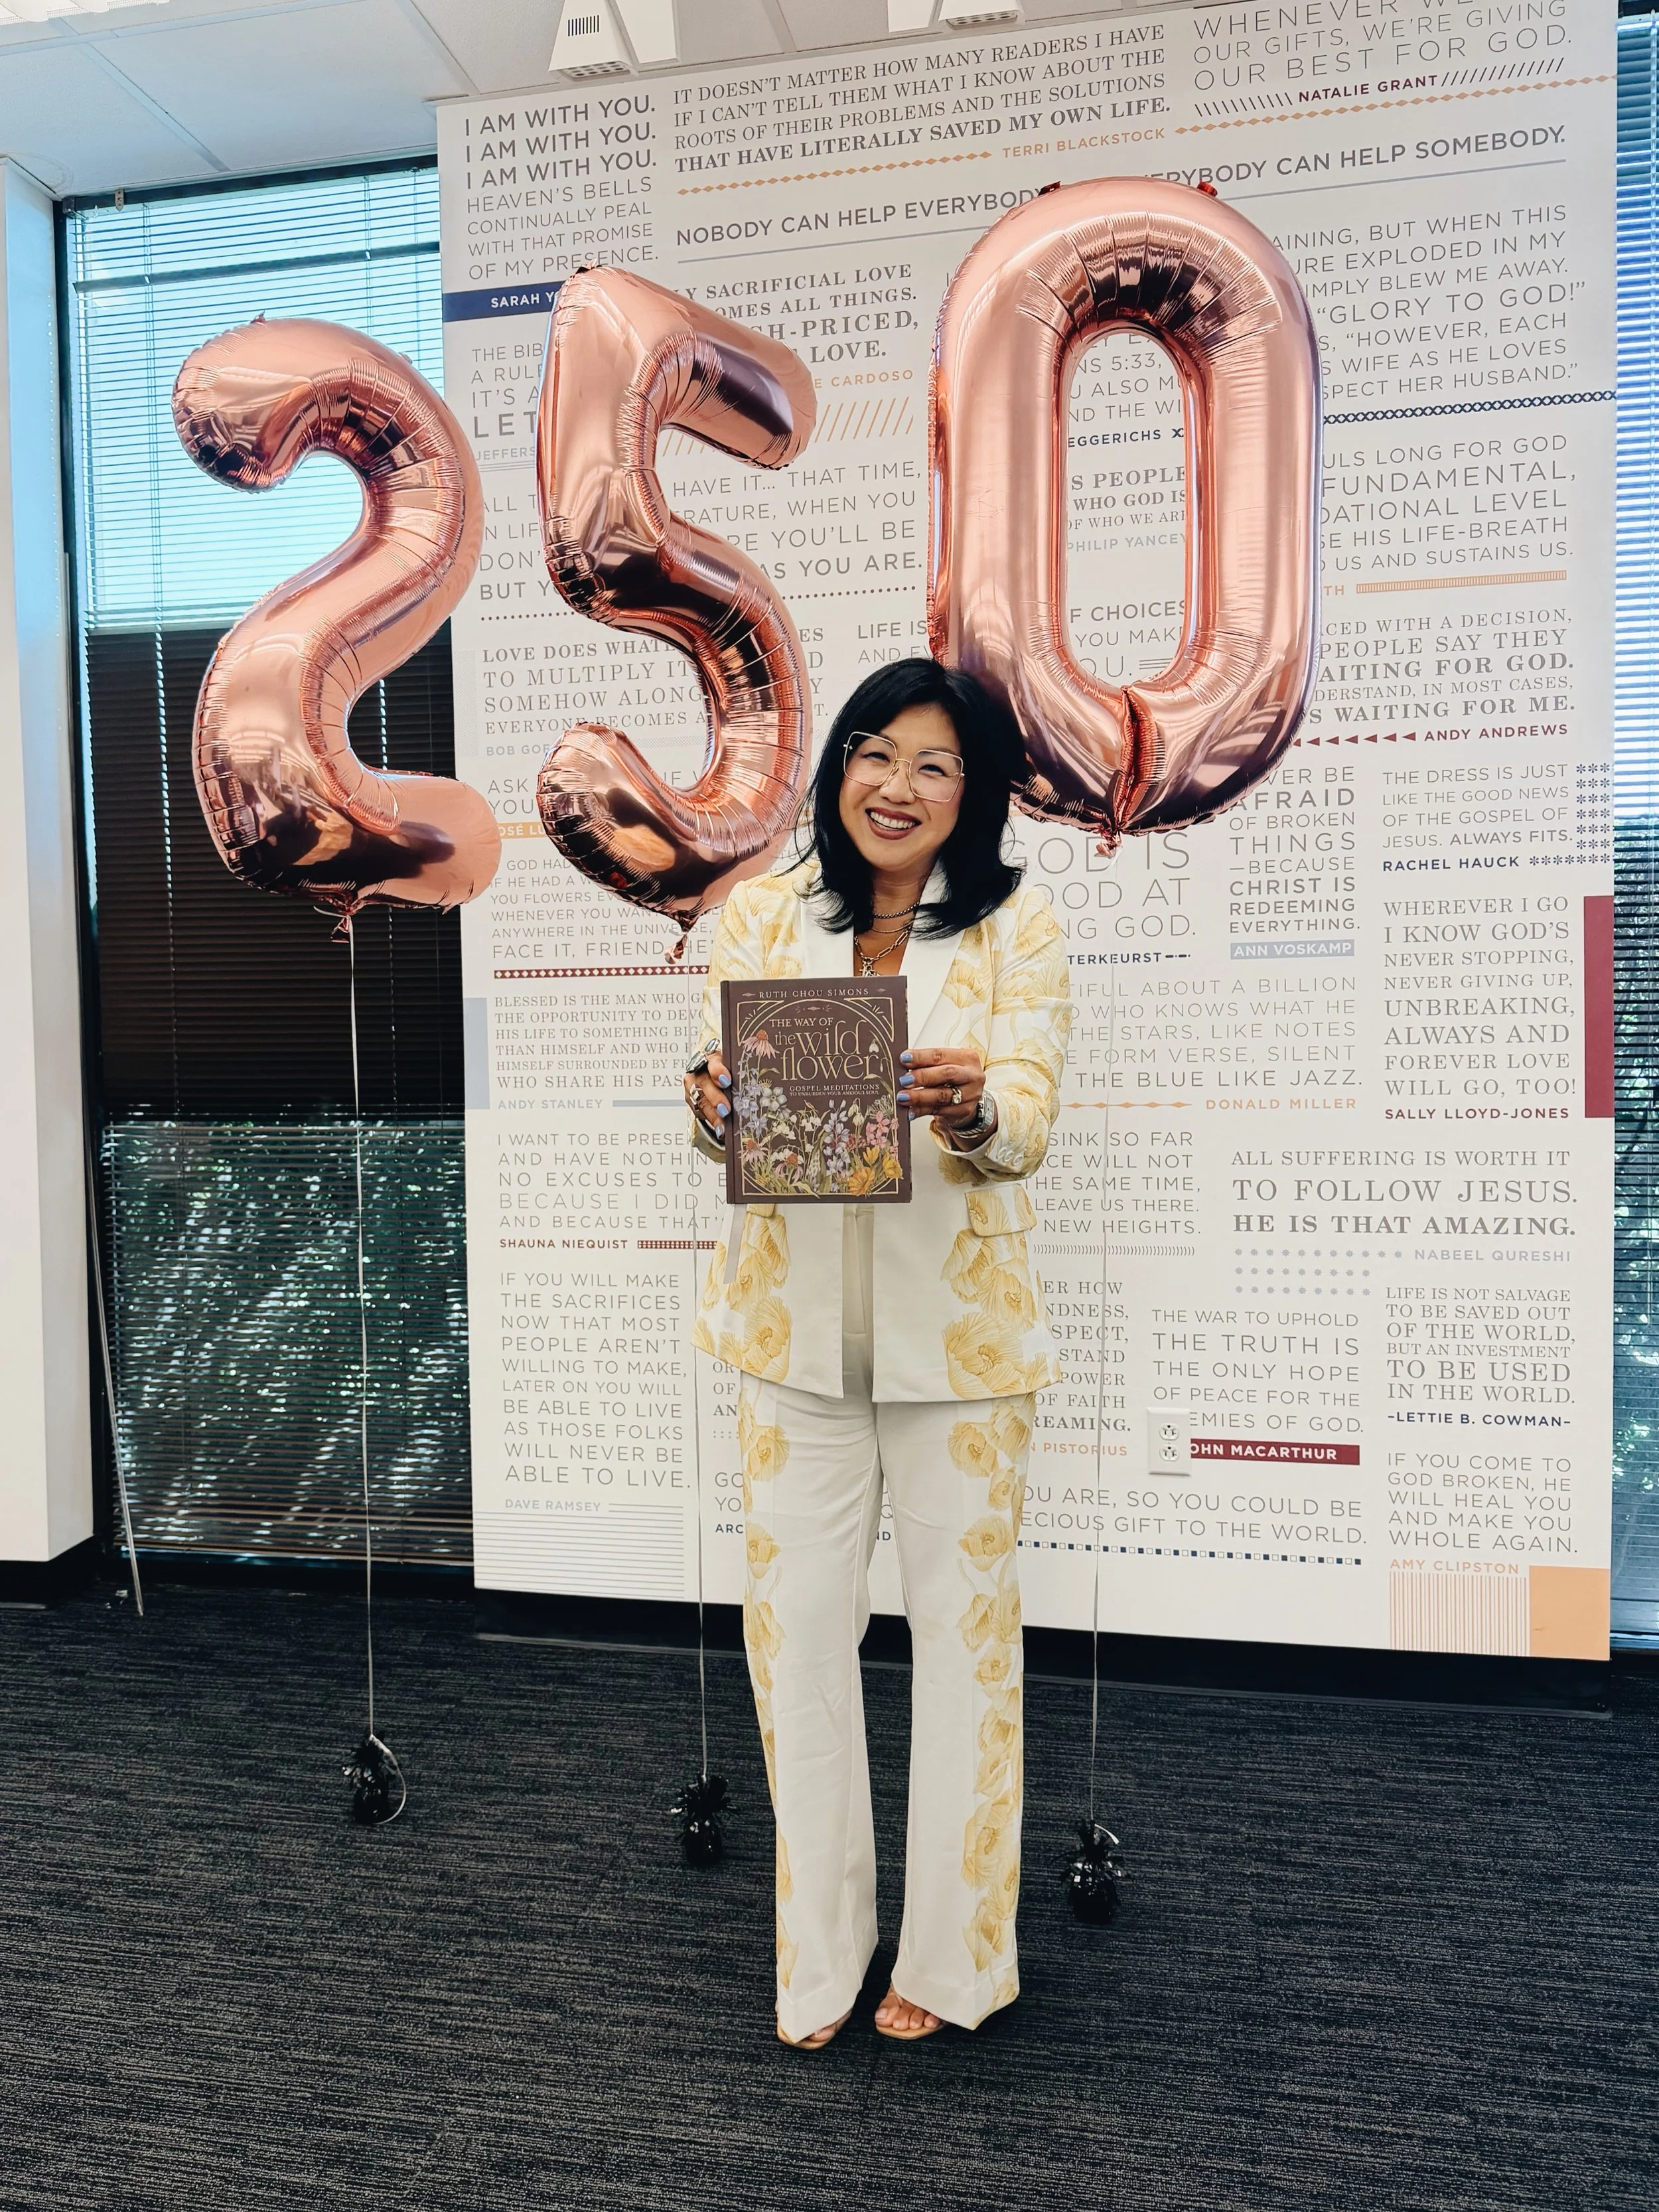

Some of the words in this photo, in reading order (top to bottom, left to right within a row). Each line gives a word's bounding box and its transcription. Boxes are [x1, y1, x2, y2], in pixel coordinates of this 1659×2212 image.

[674, 88, 692, 105] IT
[787, 65, 867, 90] MATTER
[873, 58, 918, 78] HOW
[925, 48, 985, 71] MANY
[991, 35, 1088, 62] READERS
[1095, 33, 1102, 48] I
[1109, 25, 1164, 46] HAVE
[1194, 63, 1265, 90] OUR
[1287, 48, 1374, 79] BEST
[1396, 37, 1466, 65] FOR
[1488, 25, 1571, 52] GOD.
[1299, 83, 1370, 103] NATALIE
[1377, 74, 1437, 92] GRANT
[465, 118, 470, 137] I
[480, 112, 515, 135] AM
[524, 103, 589, 129] WITH
[598, 94, 655, 118] YOU.
[675, 152, 731, 173] THAT
[737, 144, 793, 165] HAVE
[800, 127, 923, 157] LITERALLY
[930, 119, 1001, 141] SAVED
[1009, 113, 1043, 132] MY
[1050, 105, 1103, 126] OWN
[1110, 97, 1171, 118] LIFE.
[1002, 143, 1049, 158] TERRI
[1057, 127, 1165, 152] BLACKSTOCK
[584, 176, 652, 200] BELLS
[677, 219, 772, 246] NOBODY
[781, 212, 829, 234] CAN
[838, 205, 896, 228] HELP
[1276, 153, 1329, 175] CAN
[1340, 144, 1406, 169] HELP
[1415, 125, 1565, 159] SOMEBODY.
[467, 207, 596, 235] CONTINUALLY
[605, 201, 652, 219] PEAL
[706, 271, 845, 299] SACRIFICIAL
[855, 263, 911, 283] LOVE
[491, 293, 540, 309] SARAH
[1445, 292, 1484, 313] TO
[831, 369, 913, 387] CARDOSO
[787, 467, 846, 488] THAT
[858, 461, 920, 481] TIME,
[1320, 459, 1576, 498] FUNDAMENTAL,
[1354, 529, 1391, 547] HIS
[1404, 516, 1567, 544] LIFE-BREATH
[798, 557, 850, 577] YOU
[863, 552, 922, 573] ARE.
[1319, 636, 1423, 660] PEOPLE
[1435, 634, 1482, 652] SAY
[1493, 628, 1567, 649] THEY
[483, 670, 514, 688] TO
[527, 662, 655, 686] MULTIPLY
[667, 660, 695, 678] IT
[1424, 729, 1471, 742] ANDY
[1479, 723, 1567, 739] ANDREWS
[1382, 771, 1419, 785] THE
[1427, 767, 1489, 783] DRESS
[1497, 767, 1513, 780] IS
[1520, 764, 1568, 779] JUST
[1229, 832, 1355, 855] THINGS
[1383, 859, 1451, 871] RACHEL
[1459, 856, 1519, 869] HAUCK
[1230, 877, 1322, 897] CHRIST
[1334, 876, 1355, 893] IS
[1230, 898, 1354, 916] REDEEMING
[1383, 898, 1513, 916] WHEREVER
[1522, 897, 1528, 913] I
[1537, 896, 1568, 912] GO
[1115, 915, 1196, 938] GOD.
[1230, 917, 1360, 934] EVERYTHING.
[493, 944, 543, 959] FACE
[555, 943, 575, 958] IT,
[1067, 952, 1162, 966] TERKEURST
[1234, 945, 1267, 958] ANN
[1274, 942, 1353, 956] VOSKAMP
[1384, 996, 1575, 1017] UNBREAKING,
[768, 1018, 792, 1027] THE
[793, 1017, 817, 1027] WAY
[818, 1017, 834, 1026] OF
[774, 1030, 797, 1047] the
[497, 1076, 537, 1088] WHO
[545, 1075, 605, 1088] SHARE
[613, 1075, 644, 1088] HIS
[1075, 1072, 1123, 1088] THE
[1137, 1071, 1204, 1088] BLUE
[1218, 1070, 1275, 1086] LIKE
[1290, 1069, 1362, 1086] JAZZ.
[1384, 1080, 1451, 1096] WILL
[1463, 1078, 1505, 1096] GO,
[1516, 1078, 1575, 1094] TOO!
[498, 1099, 535, 1110] ANDY
[541, 1099, 603, 1109] STANLEY
[1206, 1099, 1280, 1110] DONALD
[1289, 1098, 1356, 1110] MILLER
[1385, 1108, 1436, 1120] SALLY
[1445, 1108, 1569, 1119] LLOYD-JONES
[1232, 1179, 1277, 1201] TO
[1294, 1179, 1442, 1202] FOLLOW
[1457, 1180, 1577, 1203] JESUS.
[1233, 1215, 1274, 1232] HE
[1289, 1215, 1317, 1233] IS
[1331, 1215, 1411, 1234] THAT
[1422, 1216, 1575, 1236] AMAZING.
[500, 1238, 555, 1248] SHAUNA
[562, 1239, 628, 1249] NIEQUIST
[1414, 1249, 1484, 1261] NABEEL
[1492, 1250, 1570, 1262] QURESHI
[500, 1293, 541, 1308] THE
[552, 1293, 680, 1310] SACRIFICES
[1152, 1333, 1206, 1351] THE
[1221, 1334, 1318, 1355] TRUTH
[1335, 1337, 1358, 1356] IS
[1386, 1359, 1425, 1378] TO
[1437, 1361, 1476, 1380] BE
[1488, 1362, 1570, 1382] USED
[1461, 1414, 1475, 1424] B.
[1043, 1441, 1128, 1457] PISTORIUS
[1190, 1442, 1224, 1456] OHN
[1231, 1445, 1336, 1460] MACARTHUR
[505, 1465, 569, 1483] ABLE
[581, 1467, 613, 1485] TO
[627, 1469, 690, 1489] LIVE.
[505, 1499, 540, 1509] DAVE
[545, 1500, 601, 1512] RAMSEY
[1114, 1516, 1166, 1534] GIFT
[1175, 1519, 1206, 1536] TO
[1215, 1521, 1261, 1539] THE
[1271, 1524, 1366, 1544] WORLD.
[1389, 1530, 1480, 1549] WHOLE
[1492, 1534, 1577, 1553] AGAIN.
[1390, 1558, 1425, 1570] AMY
[1433, 1560, 1518, 1575] CLIPSTON
